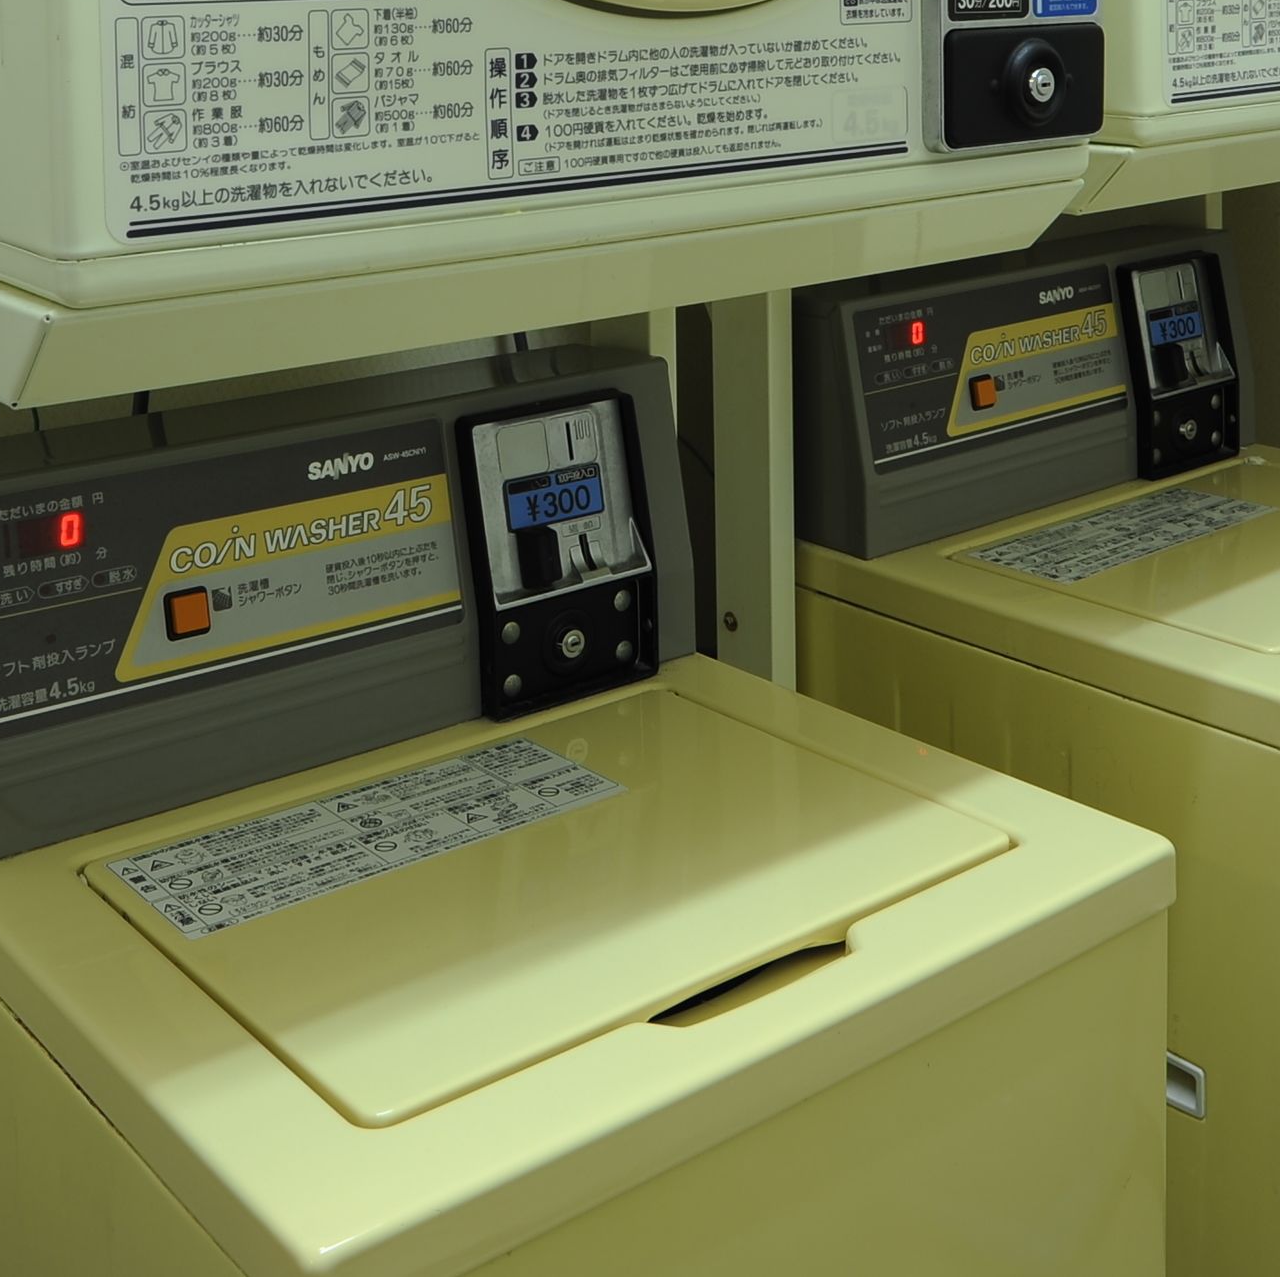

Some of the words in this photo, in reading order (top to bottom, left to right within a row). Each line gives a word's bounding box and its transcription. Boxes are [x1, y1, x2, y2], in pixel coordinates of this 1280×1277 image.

[257, 25, 303, 42] 約30分
[432, 17, 473, 33] 約60分
[374, 50, 419, 64] タオル
[191, 60, 242, 75] ブラウス
[432, 60, 473, 76] 約60分
[258, 69, 304, 88] 約30分
[433, 102, 474, 119] 約60分
[258, 115, 304, 133] 約60分
[523, 159, 555, 173] ご注意
[129, 168, 434, 212] 4.5kg以上の洗濯物を入れないでください。
[1039, 286, 1074, 305] SANYO
[912, 322, 924, 344] 0
[1019, 324, 1081, 353] WASHER
[1081, 309, 1107, 338] 45
[1159, 316, 1197, 341] ¥300
[307, 452, 374, 481] SANYO
[92, 491, 104, 504] 円
[527, 484, 591, 522] ¥300
[264, 509, 381, 554] WASHER
[384, 483, 433, 526] 45
[61, 513, 80, 547] 0
[96, 547, 108, 560] 分
[238, 583, 302, 607] シャワーボタン
